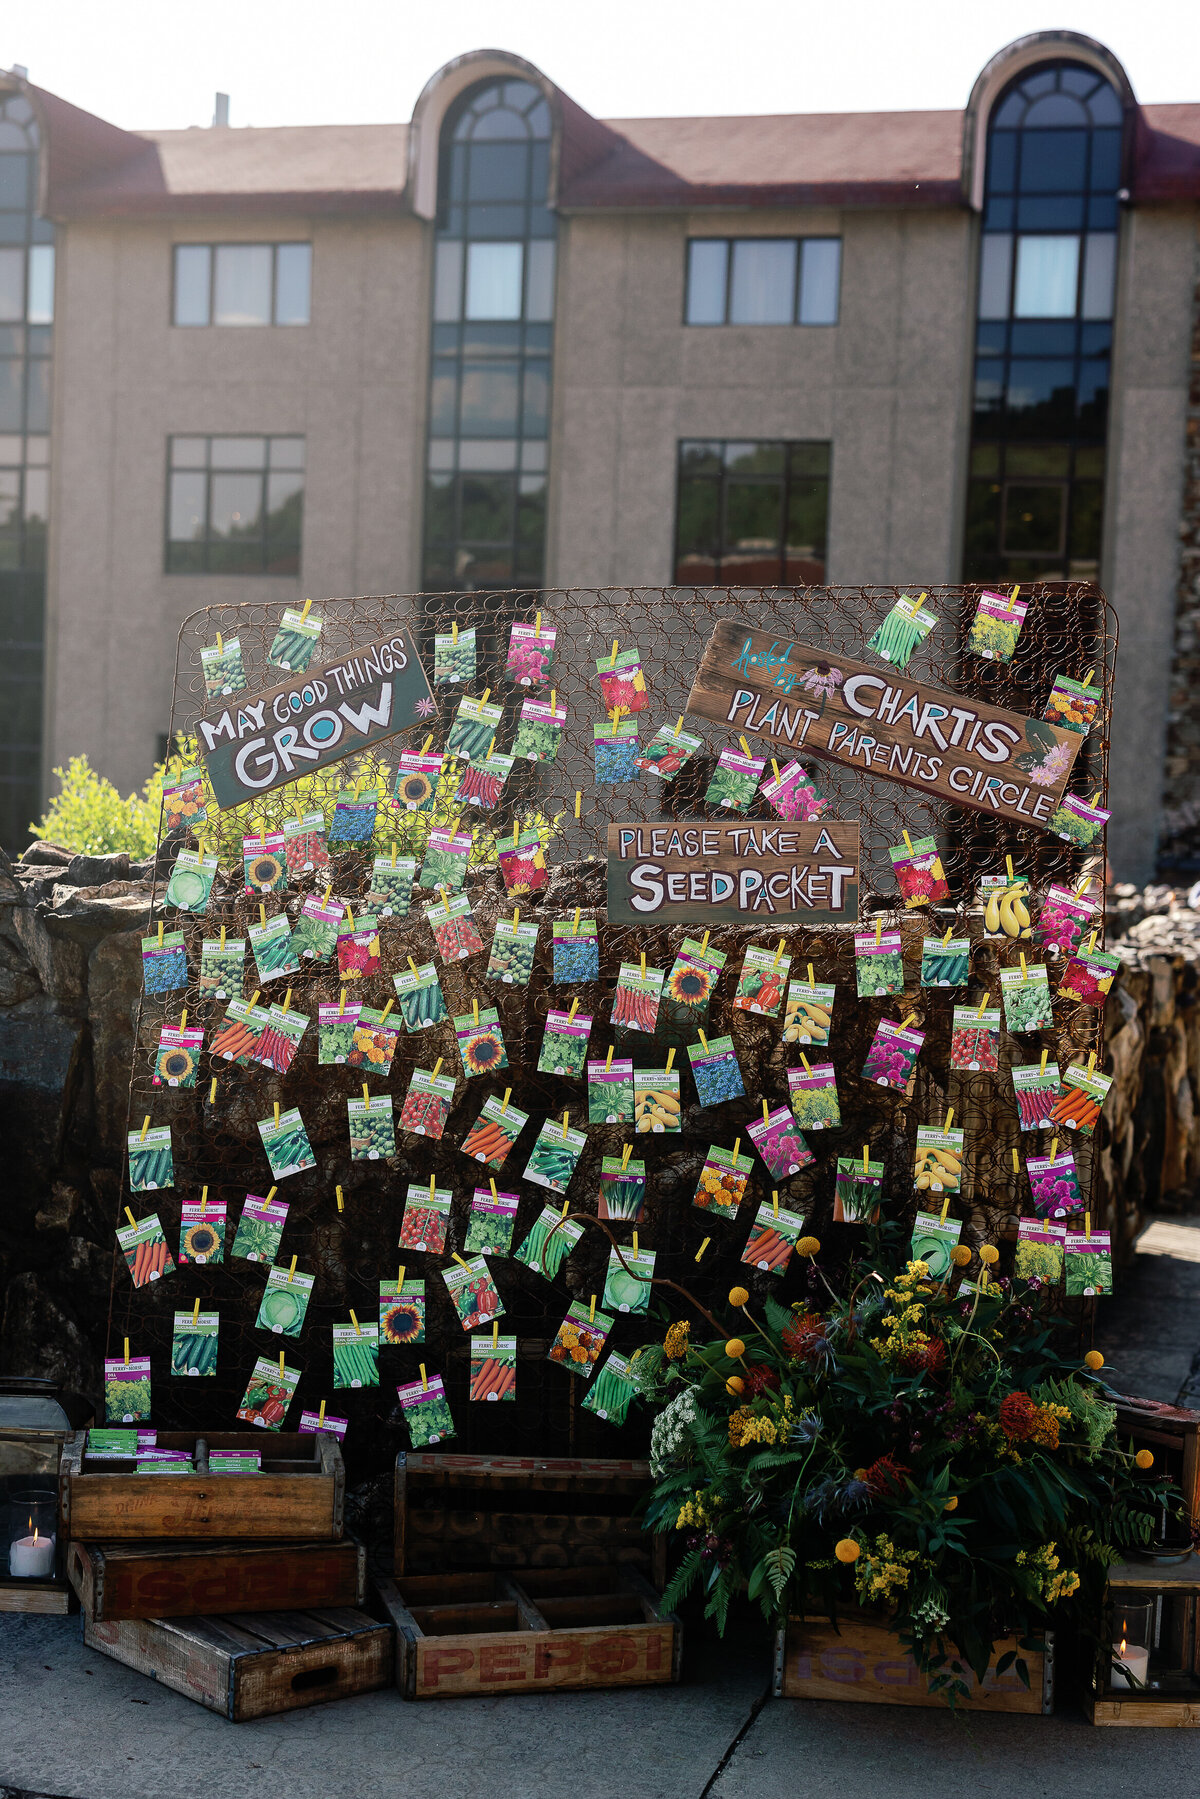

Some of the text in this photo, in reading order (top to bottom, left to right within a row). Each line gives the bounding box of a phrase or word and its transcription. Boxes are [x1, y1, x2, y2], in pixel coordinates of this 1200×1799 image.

[731, 637, 795, 678] hosted
[771, 666, 805, 694] by
[200, 637, 408, 751] MAY GOOD THINGS
[843, 674, 1020, 763] CHARTIS
[235, 682, 392, 788] GROW
[727, 689, 1055, 822] PLANT PARENTS CIRCLE
[620, 828, 843, 859] PLEASE TAKE A
[422, 1635, 662, 1688] PEPSI
